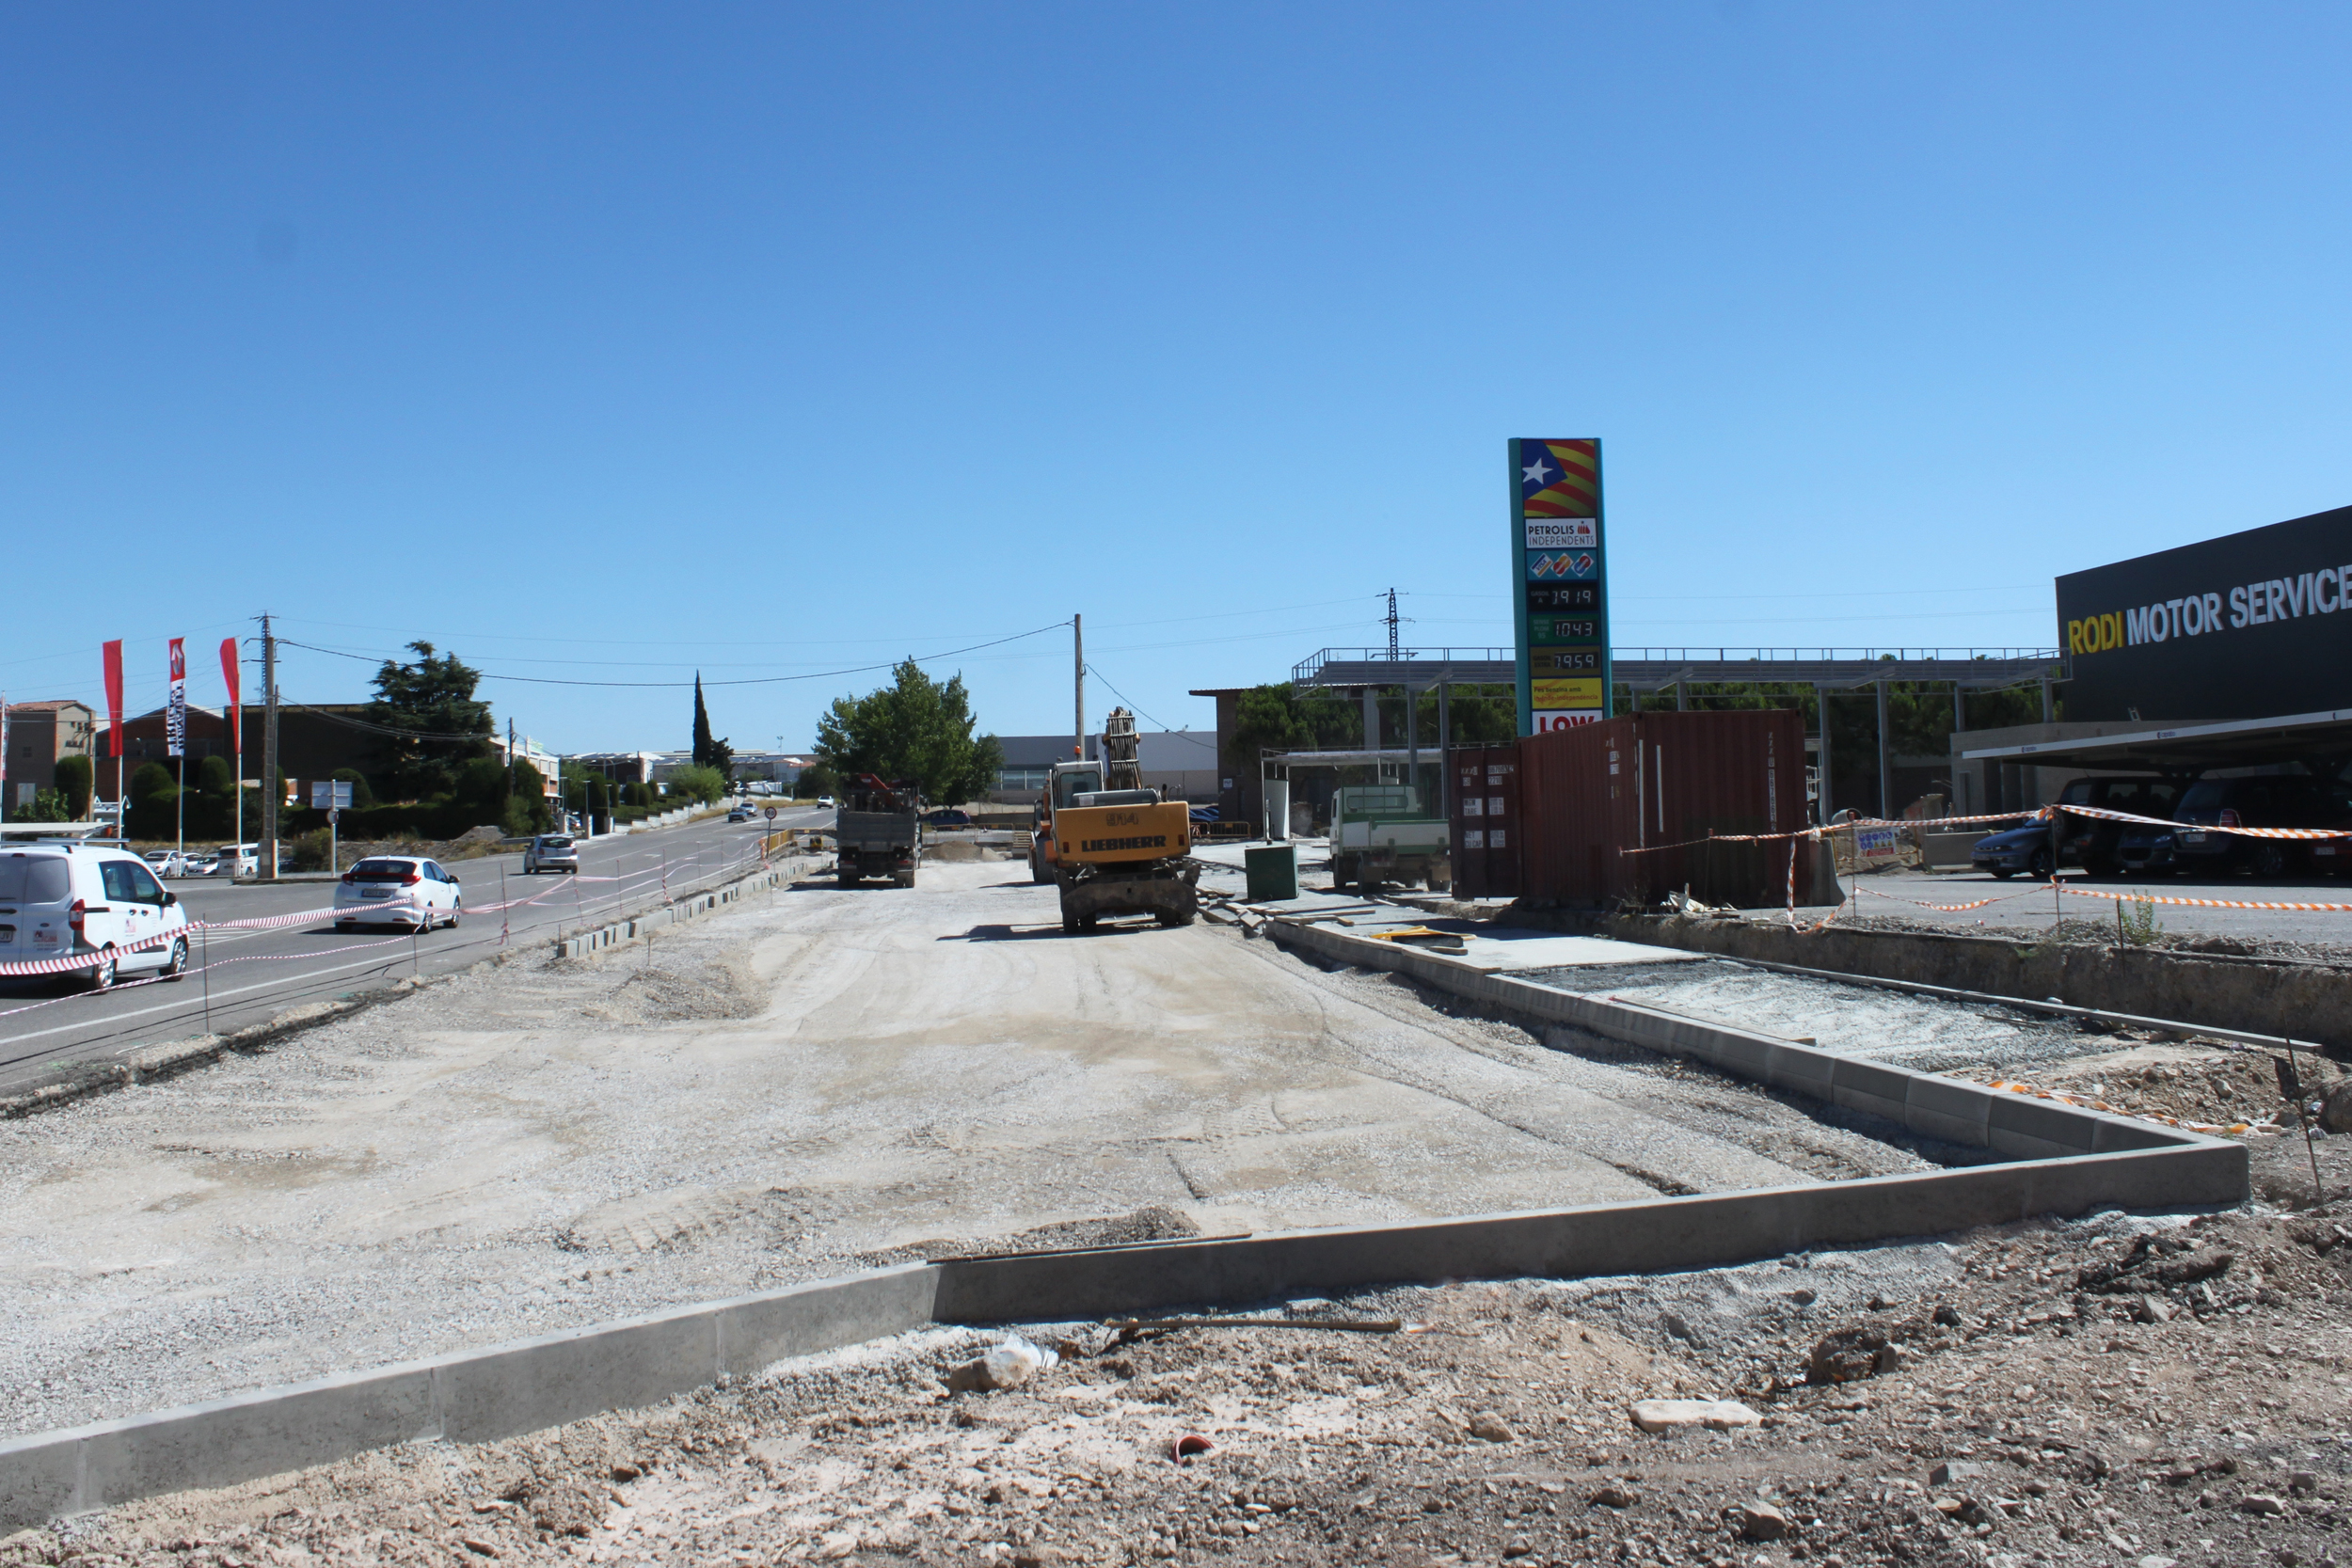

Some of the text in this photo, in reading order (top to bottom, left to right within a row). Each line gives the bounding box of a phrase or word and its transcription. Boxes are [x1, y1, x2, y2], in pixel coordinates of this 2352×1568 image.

[1529, 526, 1574, 534] PETROLIS
[1529, 536, 1595, 546] INDEPENDENTS
[2069, 564, 2352, 656] RODI MOTOR SERVICE
[1106, 812, 1139, 826] 914
[1082, 835, 1167, 852] LIEBHERR
